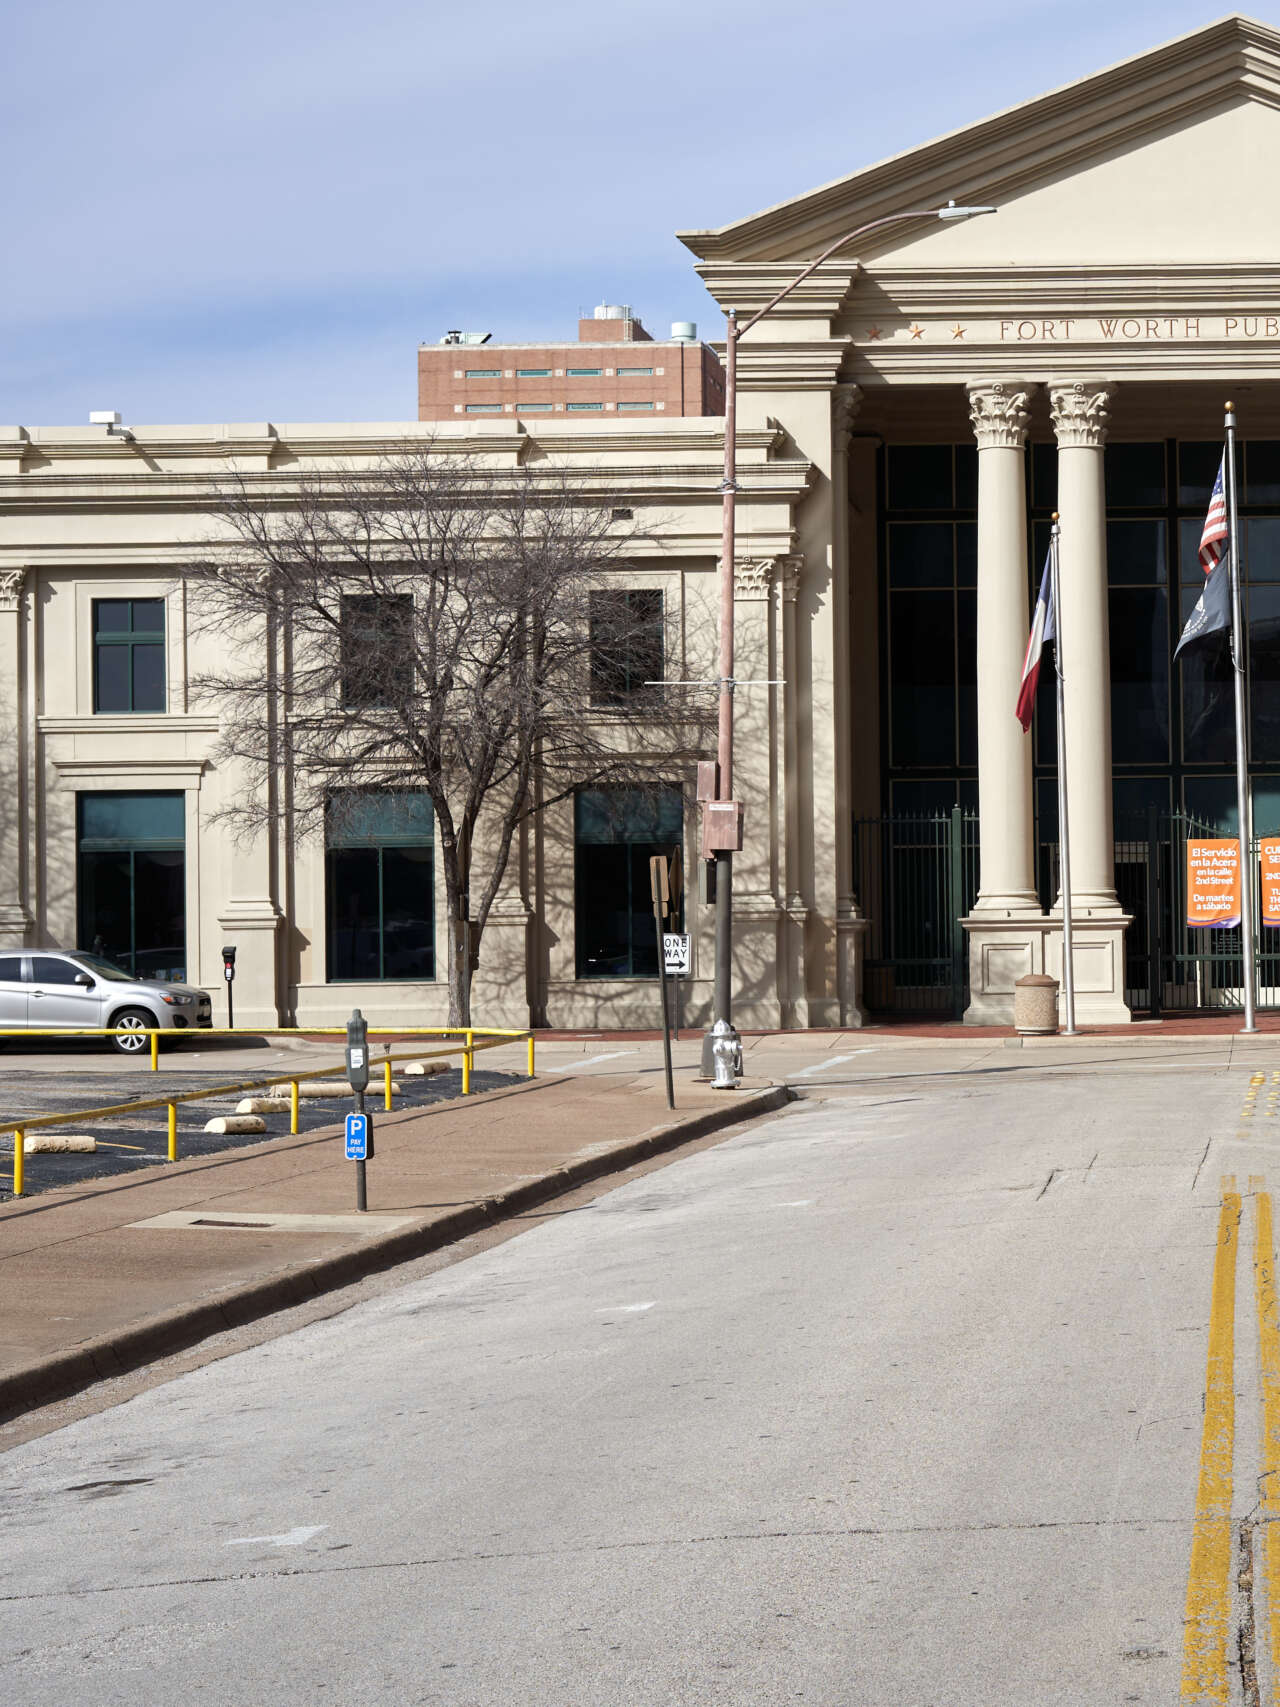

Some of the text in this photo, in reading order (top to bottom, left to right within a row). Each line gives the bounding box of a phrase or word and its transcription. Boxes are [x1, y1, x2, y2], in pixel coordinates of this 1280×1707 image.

[999, 319, 1075, 341] FORT
[1097, 318, 1201, 339] WORTH
[1192, 848, 1237, 857] El Servicio
[1202, 858, 1210, 867] la
[1211, 858, 1237, 867] Acera
[1195, 877, 1234, 885] 2nd Street
[1193, 894, 1234, 902] De martes
[664, 938, 687, 948] ONE
[664, 948, 687, 958] WAY
[351, 1119, 362, 1136] P
